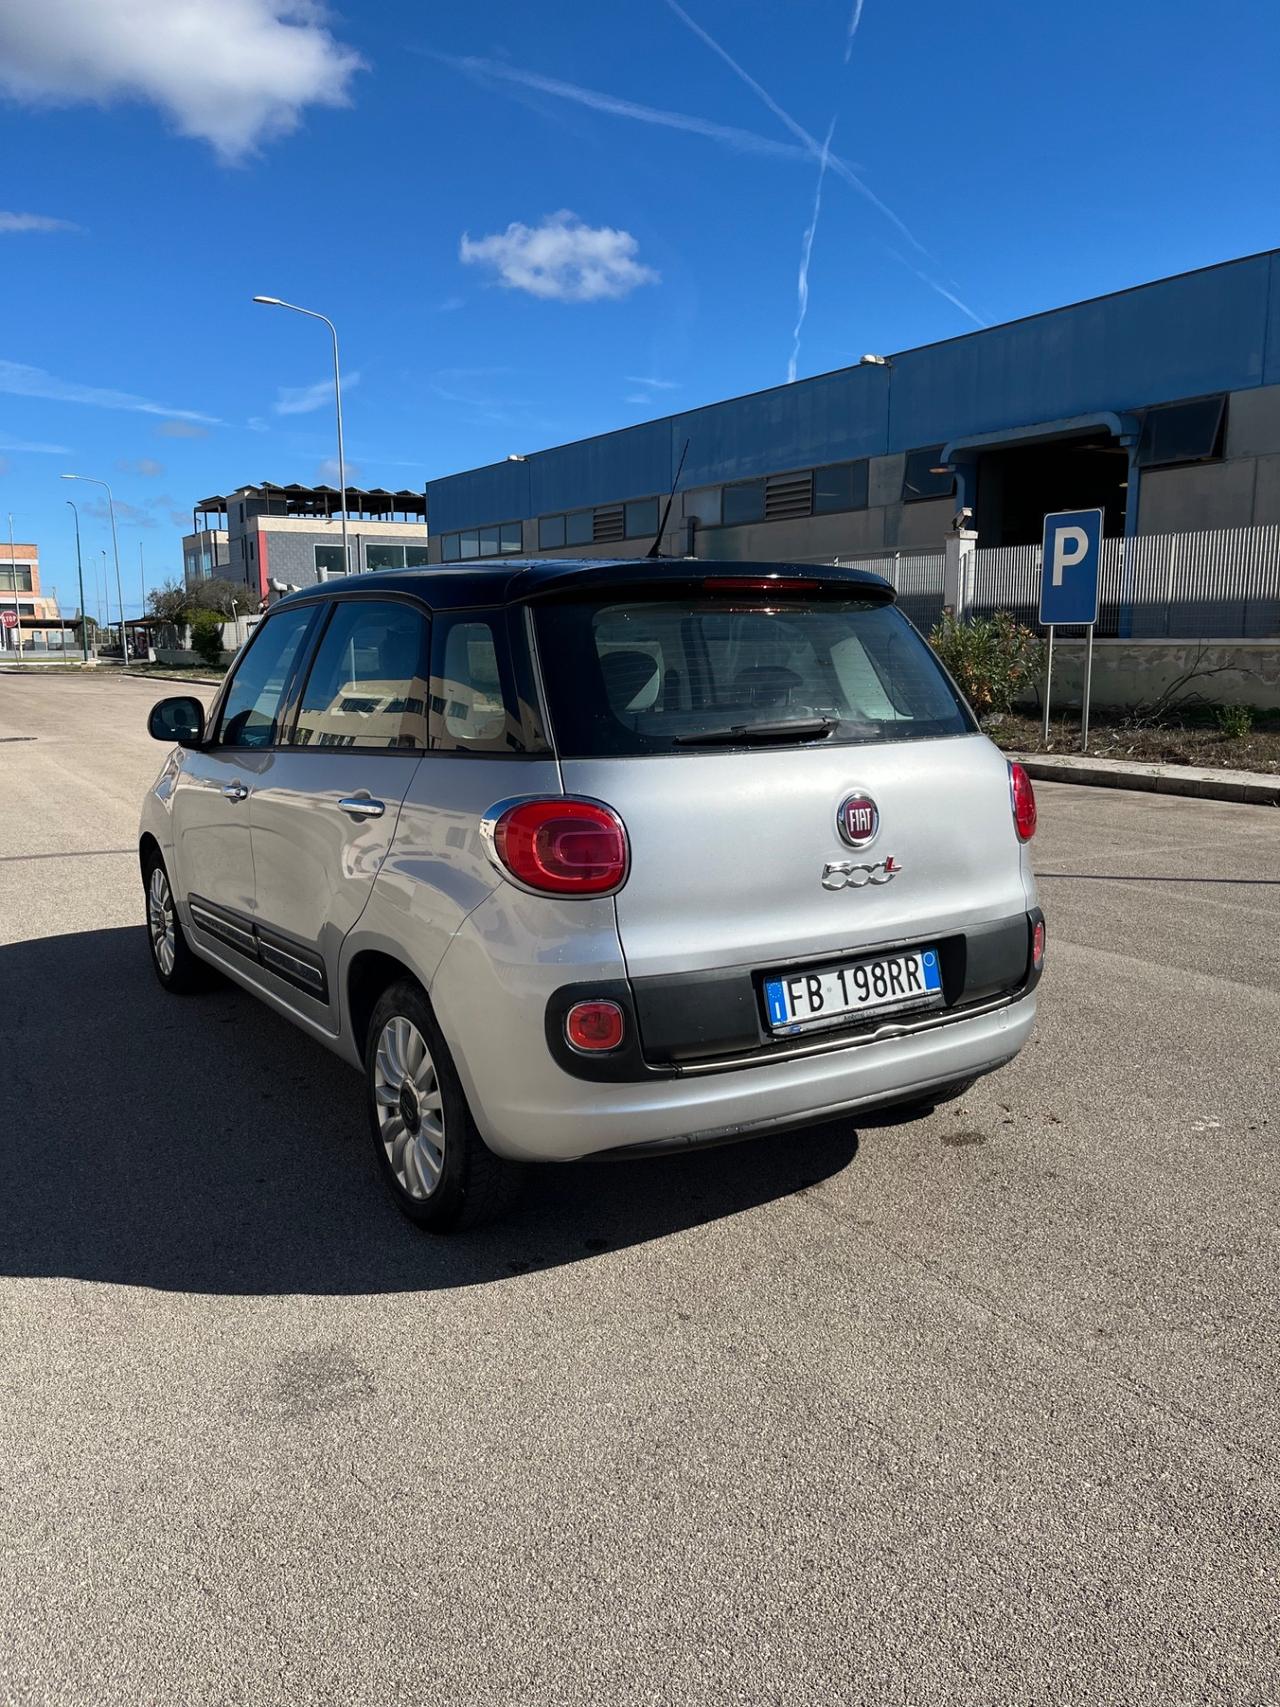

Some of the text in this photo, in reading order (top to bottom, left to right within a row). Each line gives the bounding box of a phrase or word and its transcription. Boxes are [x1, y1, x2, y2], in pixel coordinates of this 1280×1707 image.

[1052, 526, 1089, 586] P
[2, 615, 17, 623] STOP
[849, 808, 872, 832] FIAT
[822, 855, 902, 891] 500L
[786, 957, 922, 1017] FB 198RR
